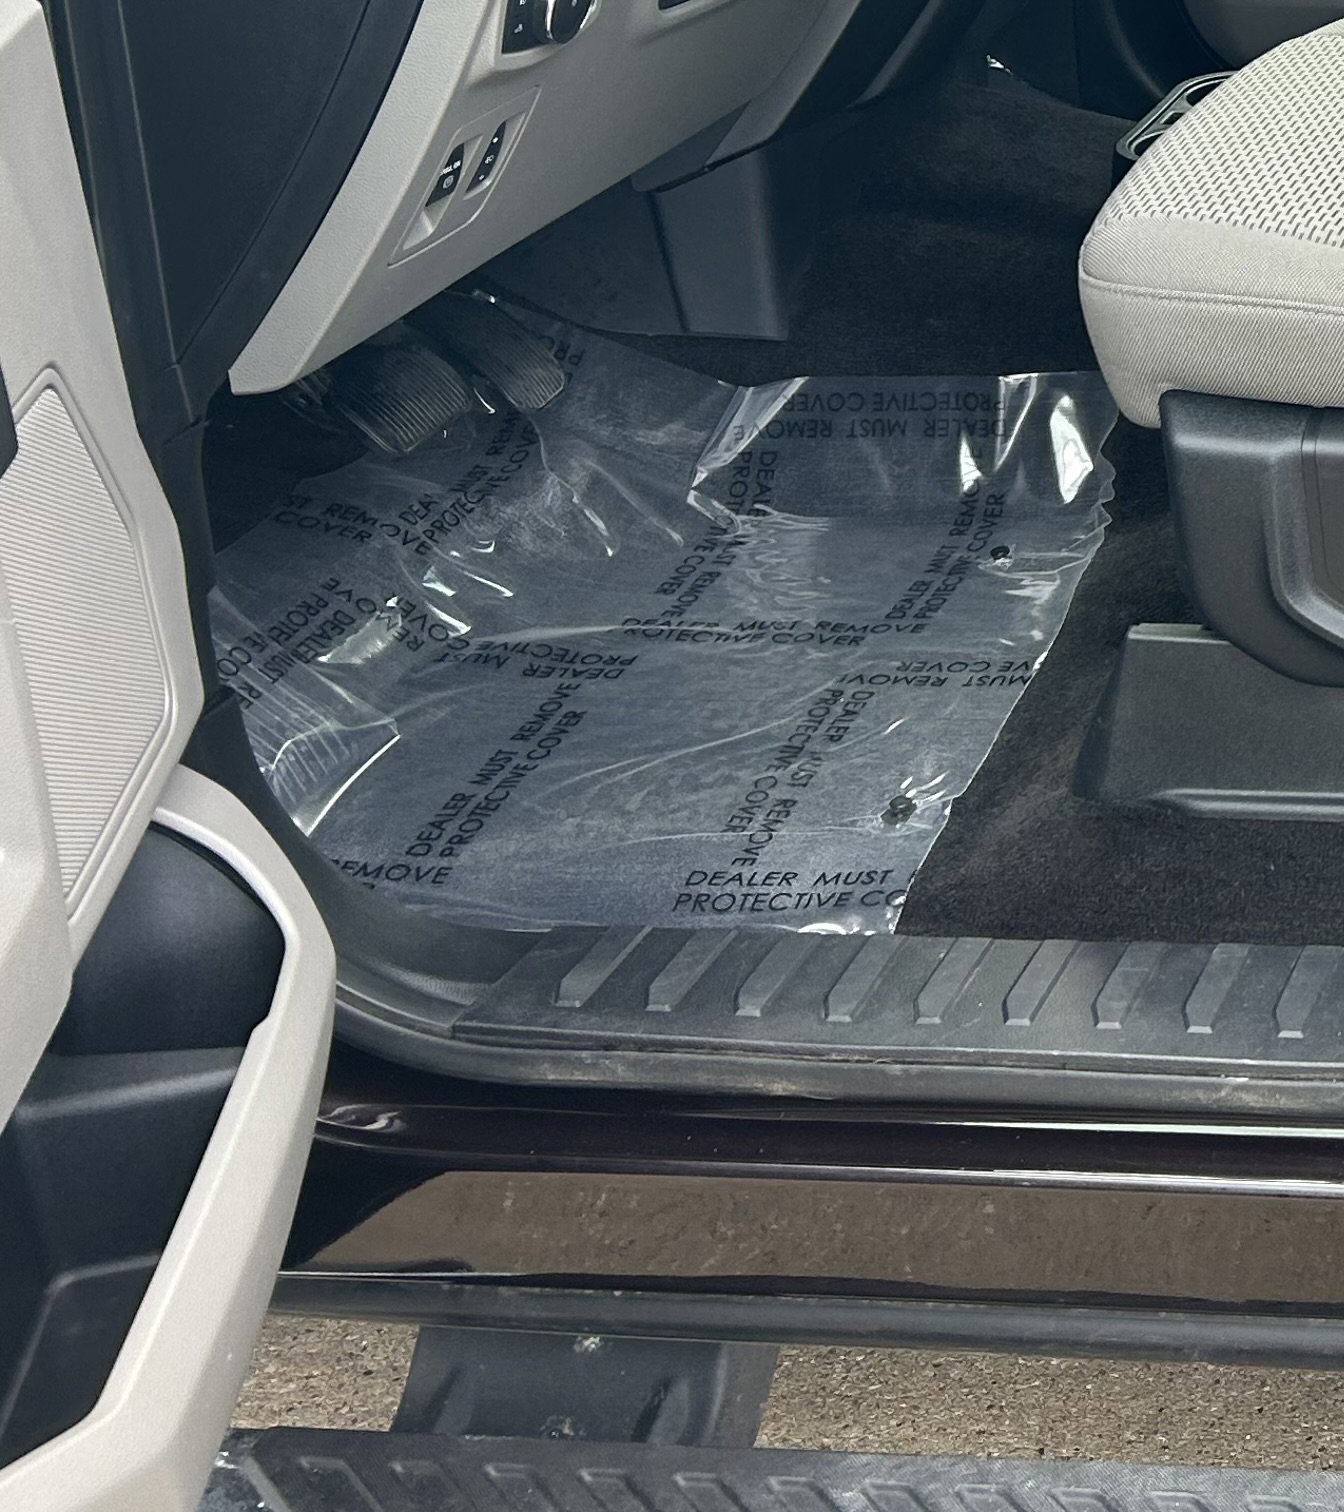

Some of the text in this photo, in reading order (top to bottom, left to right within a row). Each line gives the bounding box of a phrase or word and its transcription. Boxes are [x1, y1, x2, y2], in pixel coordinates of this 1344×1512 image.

[846, 418, 908, 439] MUST
[275, 510, 373, 544] COVER
[966, 492, 1006, 554] COVER
[770, 631, 867, 647] COVER
[813, 620, 932, 635] REMOVE
[473, 639, 641, 667] PROTECTIVE
[897, 659, 990, 673] COVER
[521, 660, 627, 681] DEALER
[404, 681, 583, 858] DEALER MUST REMOVE
[439, 709, 589, 858] PROTECTIVE COVER
[720, 775, 780, 834] COVER
[731, 798, 797, 870] REMOVE
[684, 868, 895, 888] DEALER MUST
[671, 890, 850, 914] PROTECTIVE
